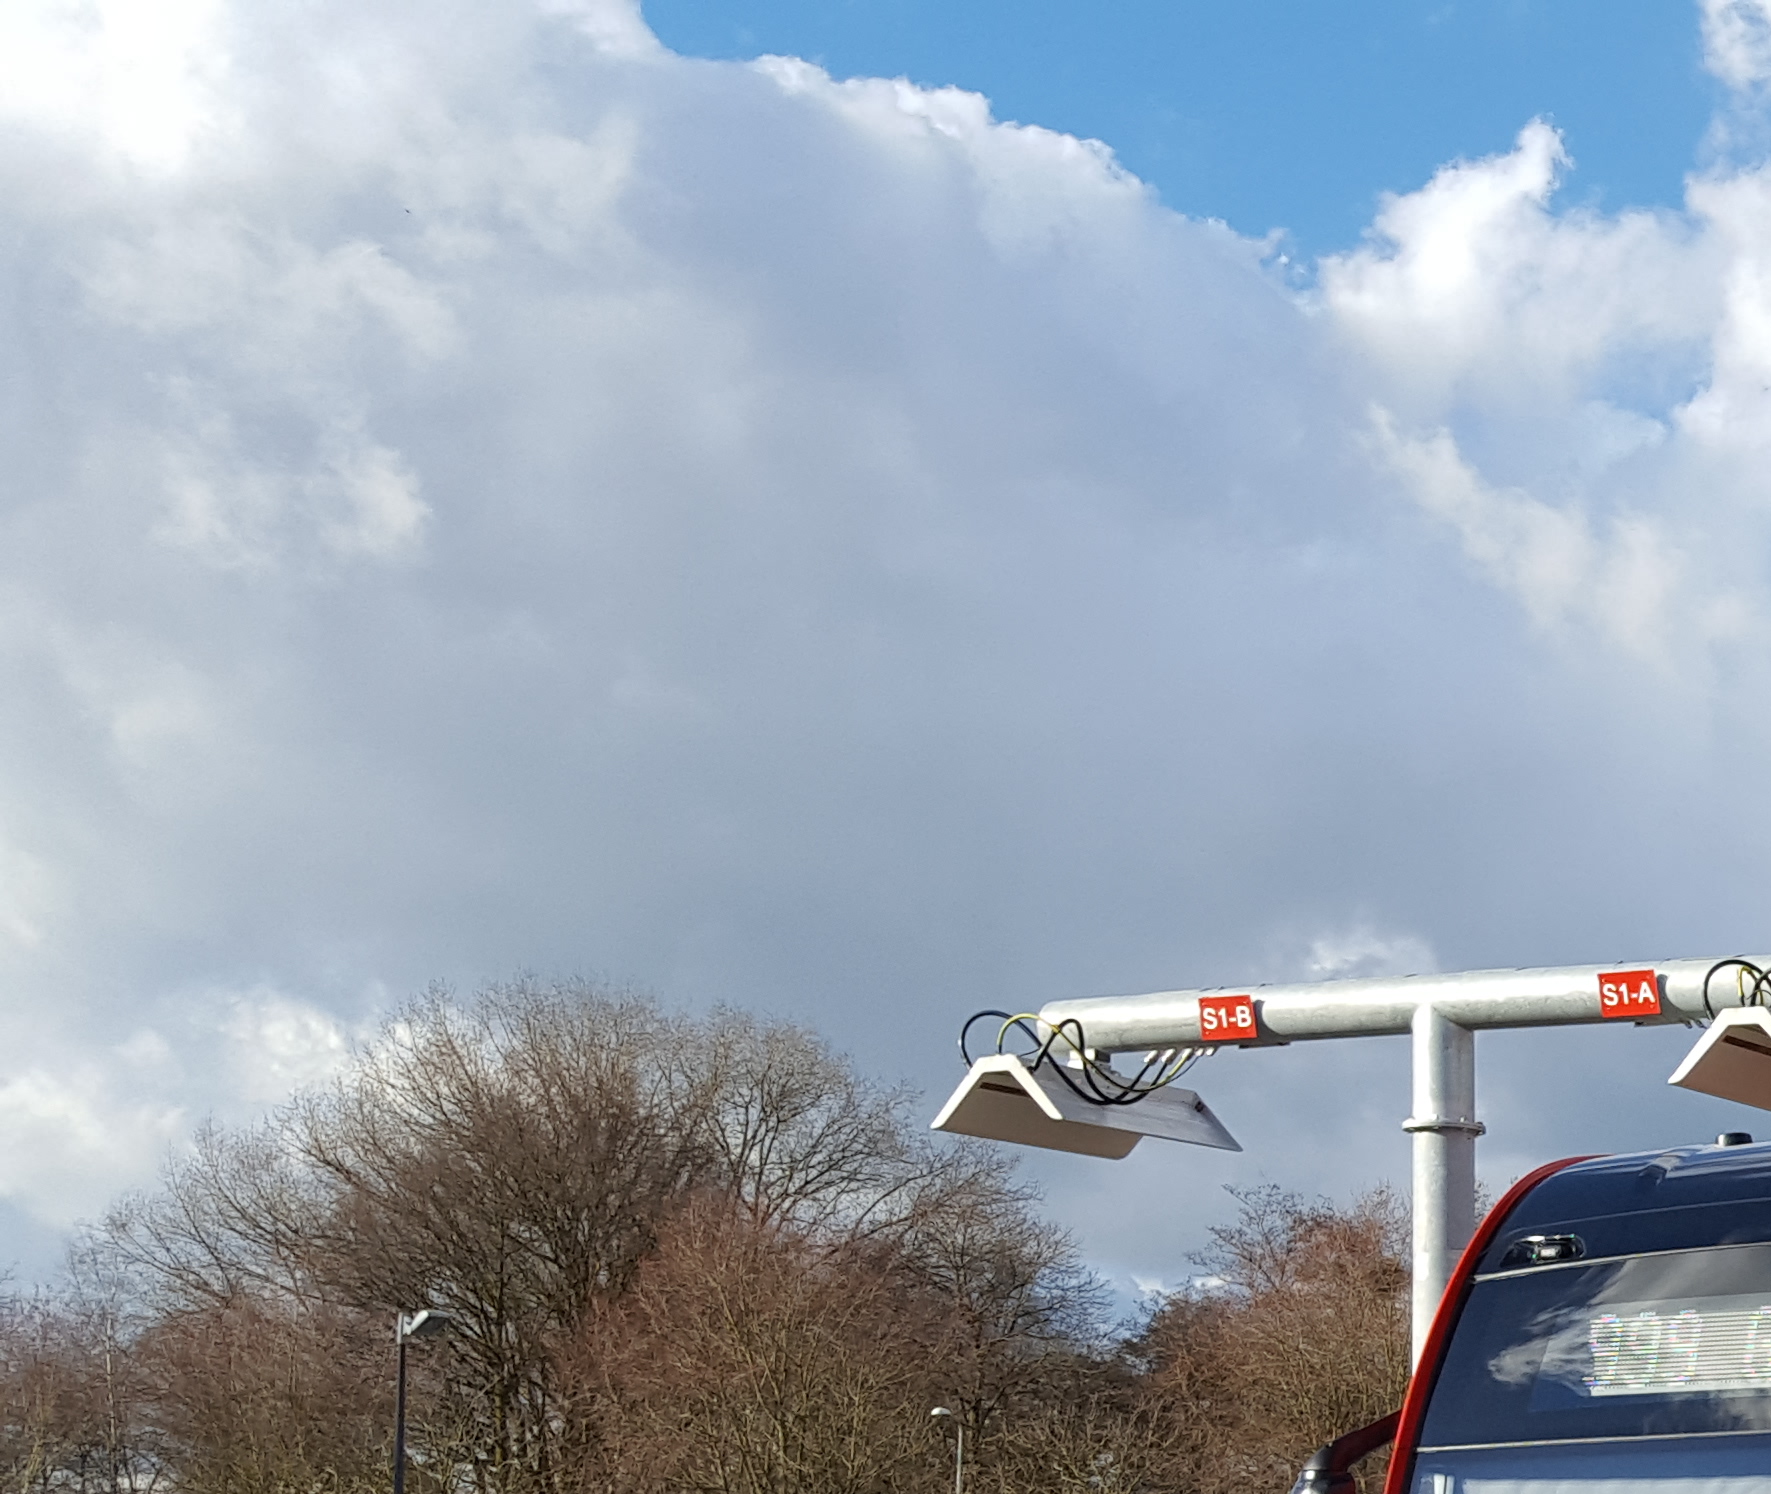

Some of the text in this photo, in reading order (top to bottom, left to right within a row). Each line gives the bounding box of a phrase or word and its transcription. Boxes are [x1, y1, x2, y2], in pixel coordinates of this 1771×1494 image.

[1602, 982, 1656, 1007] S1-A
[1202, 1005, 1253, 1030] S1-B
[1587, 1310, 1702, 1388] 999
